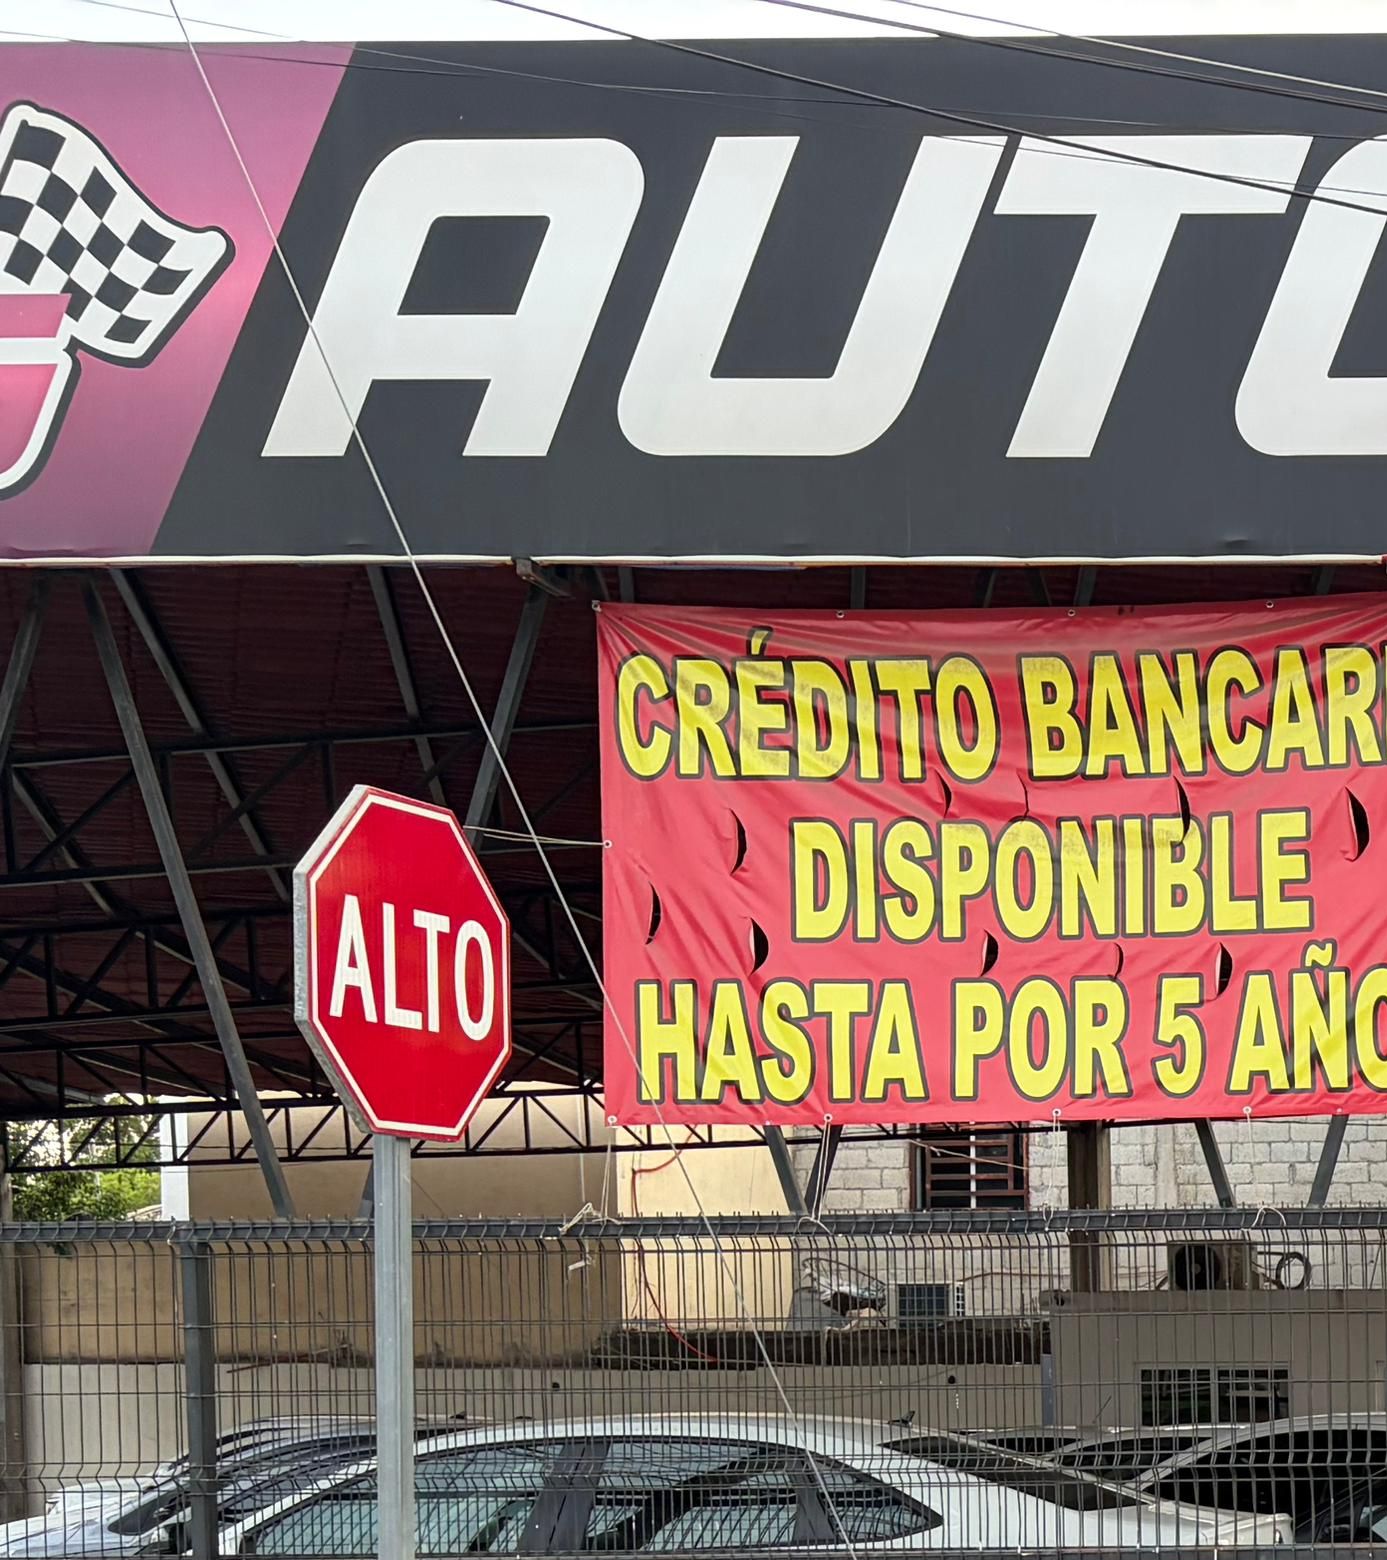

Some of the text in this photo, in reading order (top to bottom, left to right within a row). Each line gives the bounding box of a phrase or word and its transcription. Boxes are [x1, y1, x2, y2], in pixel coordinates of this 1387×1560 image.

[614, 627, 998, 782] CRÉDITO
[790, 807, 1316, 943] DISPONIBLE
[329, 893, 496, 1042] ALTO
[636, 977, 932, 1106] HASTA
[951, 975, 1133, 1103] POR
[1152, 972, 1206, 1099] 5
